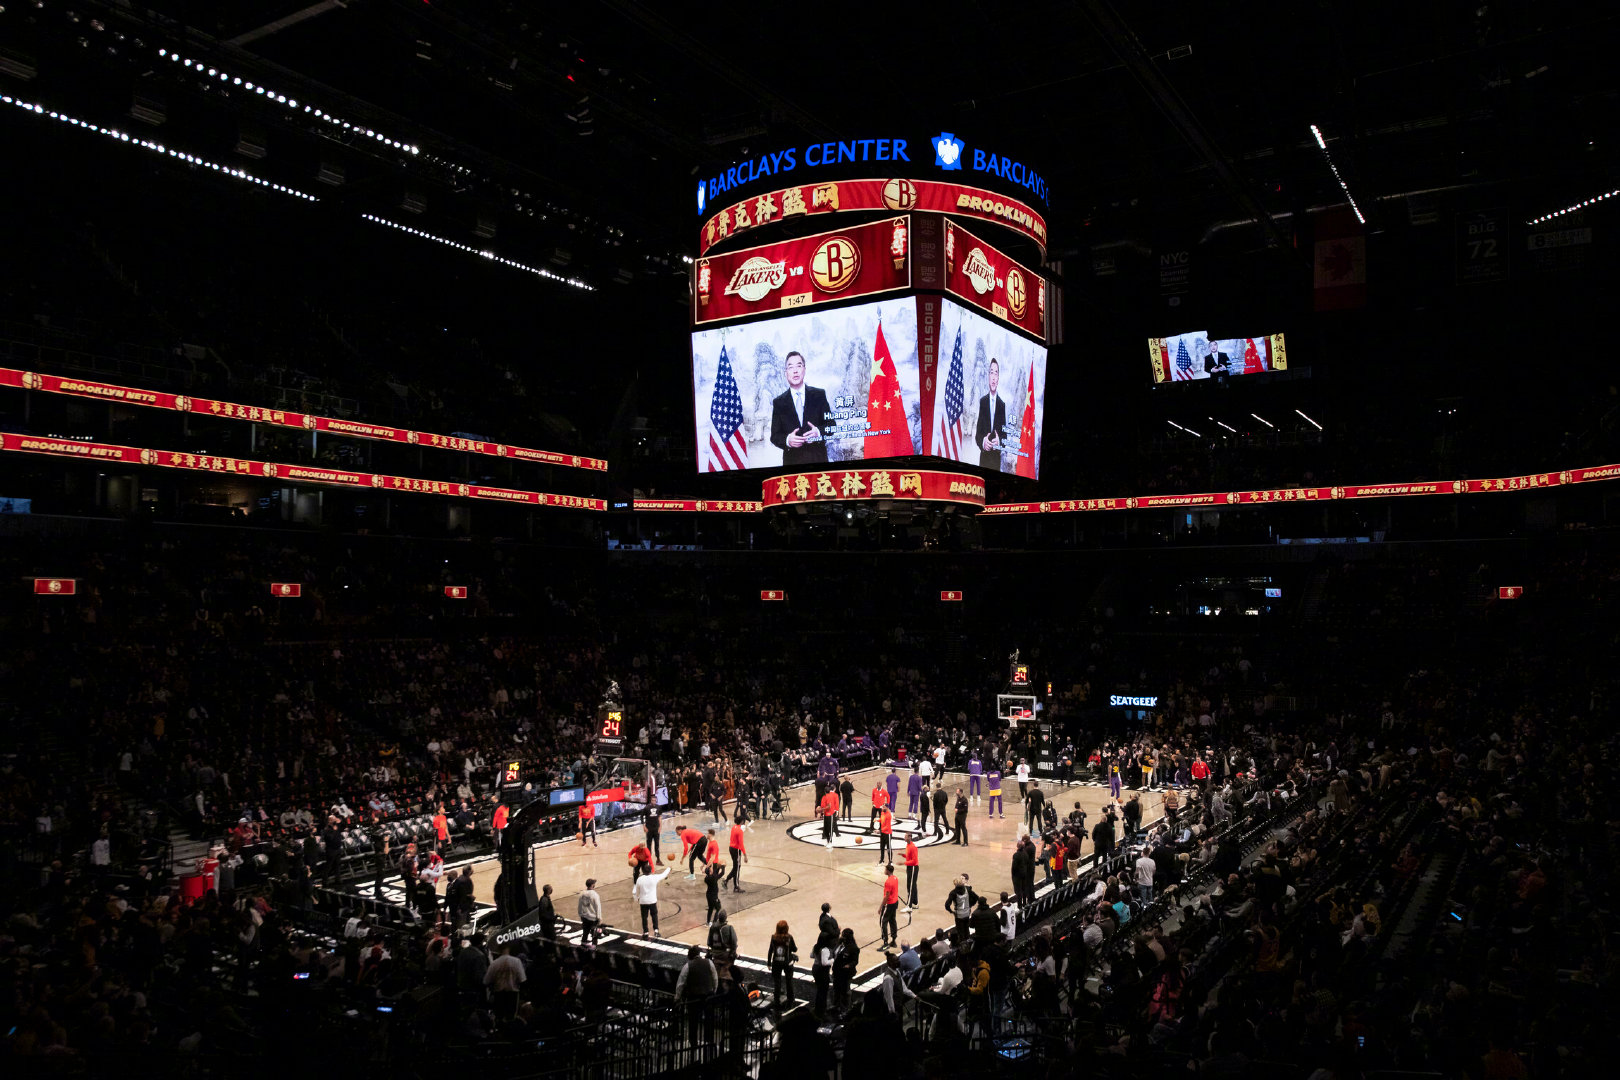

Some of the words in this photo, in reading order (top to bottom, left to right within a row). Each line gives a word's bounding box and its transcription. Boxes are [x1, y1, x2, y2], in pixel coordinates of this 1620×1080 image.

[709, 148, 797, 200] BARCLAYS
[804, 138, 911, 166] CENTER
[973, 148, 1046, 199] BARCLAYS
[705, 183, 840, 243] 布鲁克林篮网
[957, 194, 1033, 229] BROOKLYN
[1466, 238, 1499, 259] 72
[1160, 251, 1190, 265] NYC
[730, 257, 782, 292] LAKERS
[966, 255, 996, 292] LAKERS
[788, 295, 806, 306] 1:47
[924, 302, 934, 373] BIOSTEEL
[60, 381, 124, 398] BROOKLYN
[126, 391, 157, 402] NETS
[209, 400, 286, 424] 布鲁克林篮网
[824, 411, 850, 421] Huang
[850, 408, 868, 419] Ping
[328, 421, 373, 435] BROOKLYN
[374, 428, 395, 438] NETS
[21, 439, 90, 456] BROOKLYN
[91, 447, 123, 458] NETS
[431, 434, 485, 453] 布鲁克林篮网
[170, 452, 251, 473] 布鲁克林篮网
[515, 449, 548, 461] BROOKLYN
[288, 469, 337, 482] BROOKLYN
[336, 474, 360, 484] NETS
[392, 476, 450, 493] 布鲁克林篮网
[1480, 474, 1549, 491] 布鲁克林篮网
[477, 488, 512, 500] BROOKLYN
[776, 471, 923, 500] 布鲁克林篮网
[1357, 486, 1408, 495] BROOKLYN
[1410, 485, 1437, 493] NETS
[1148, 497, 1191, 506] BROOKLYN
[1250, 489, 1319, 502] 布鲁克林篮网
[1058, 499, 1116, 511] 布鲁克林篮网
[1014, 672, 1026, 682] 24
[1110, 694, 1158, 707] SEATGEEK
[602, 720, 620, 737] 24
[506, 770, 517, 781] 24
[527, 869, 534, 885] TV
[496, 922, 541, 946] coinbase
